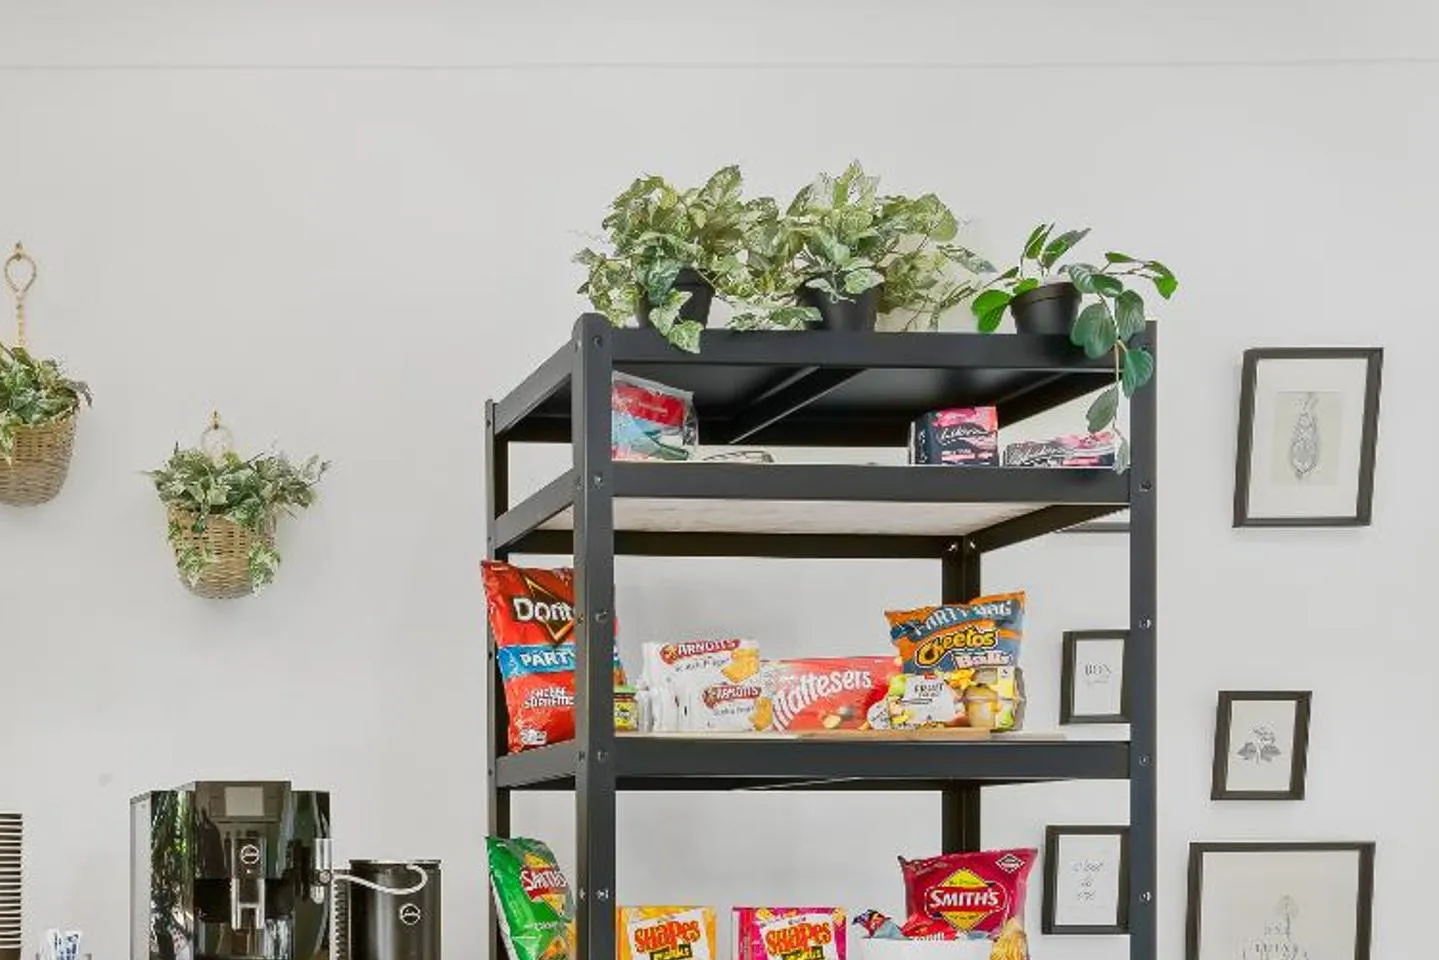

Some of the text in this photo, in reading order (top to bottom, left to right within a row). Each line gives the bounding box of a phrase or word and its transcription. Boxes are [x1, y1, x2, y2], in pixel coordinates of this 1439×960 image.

[918, 626, 995, 664] Cheetos
[765, 669, 872, 737] Maltesers
[930, 888, 999, 908] SMITH'S
